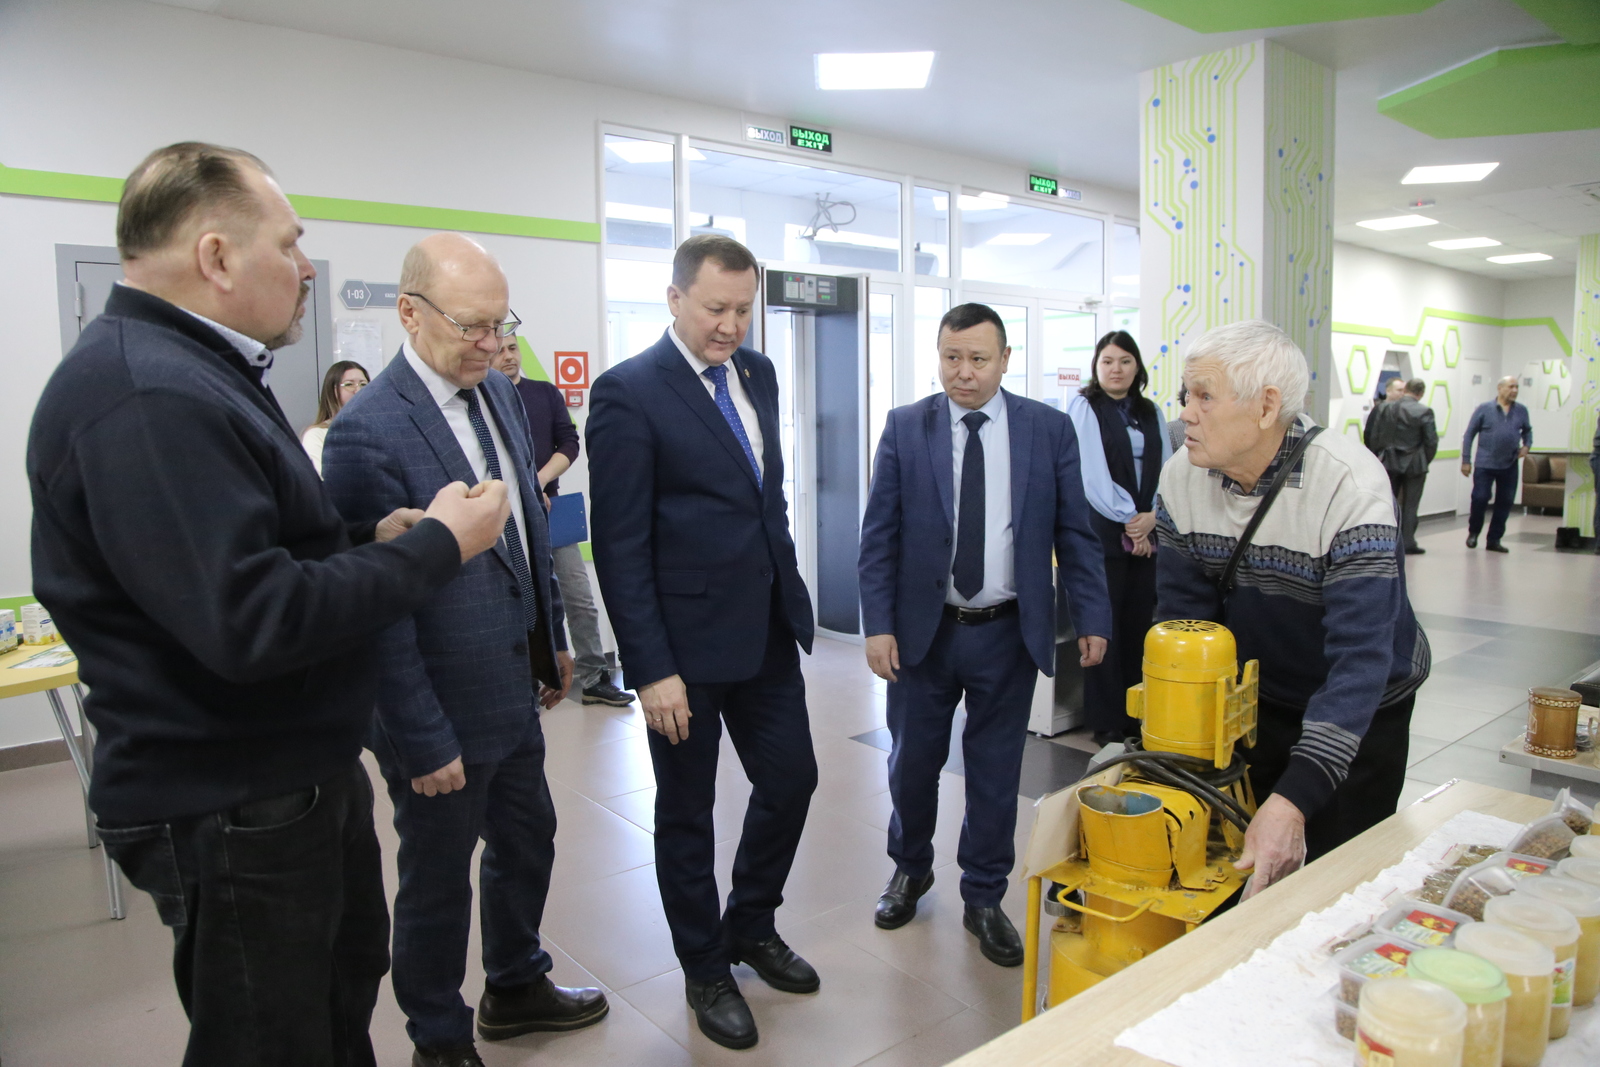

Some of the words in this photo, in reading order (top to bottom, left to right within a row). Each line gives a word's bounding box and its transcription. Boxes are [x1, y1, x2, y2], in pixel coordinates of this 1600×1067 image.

[792, 128, 830, 145] ВЫХОД
[797, 139, 824, 150] EXIT
[1031, 176, 1057, 190] ВЫХОД
[1033, 185, 1053, 195] EXIT
[347, 289, 365, 299] 1-03
